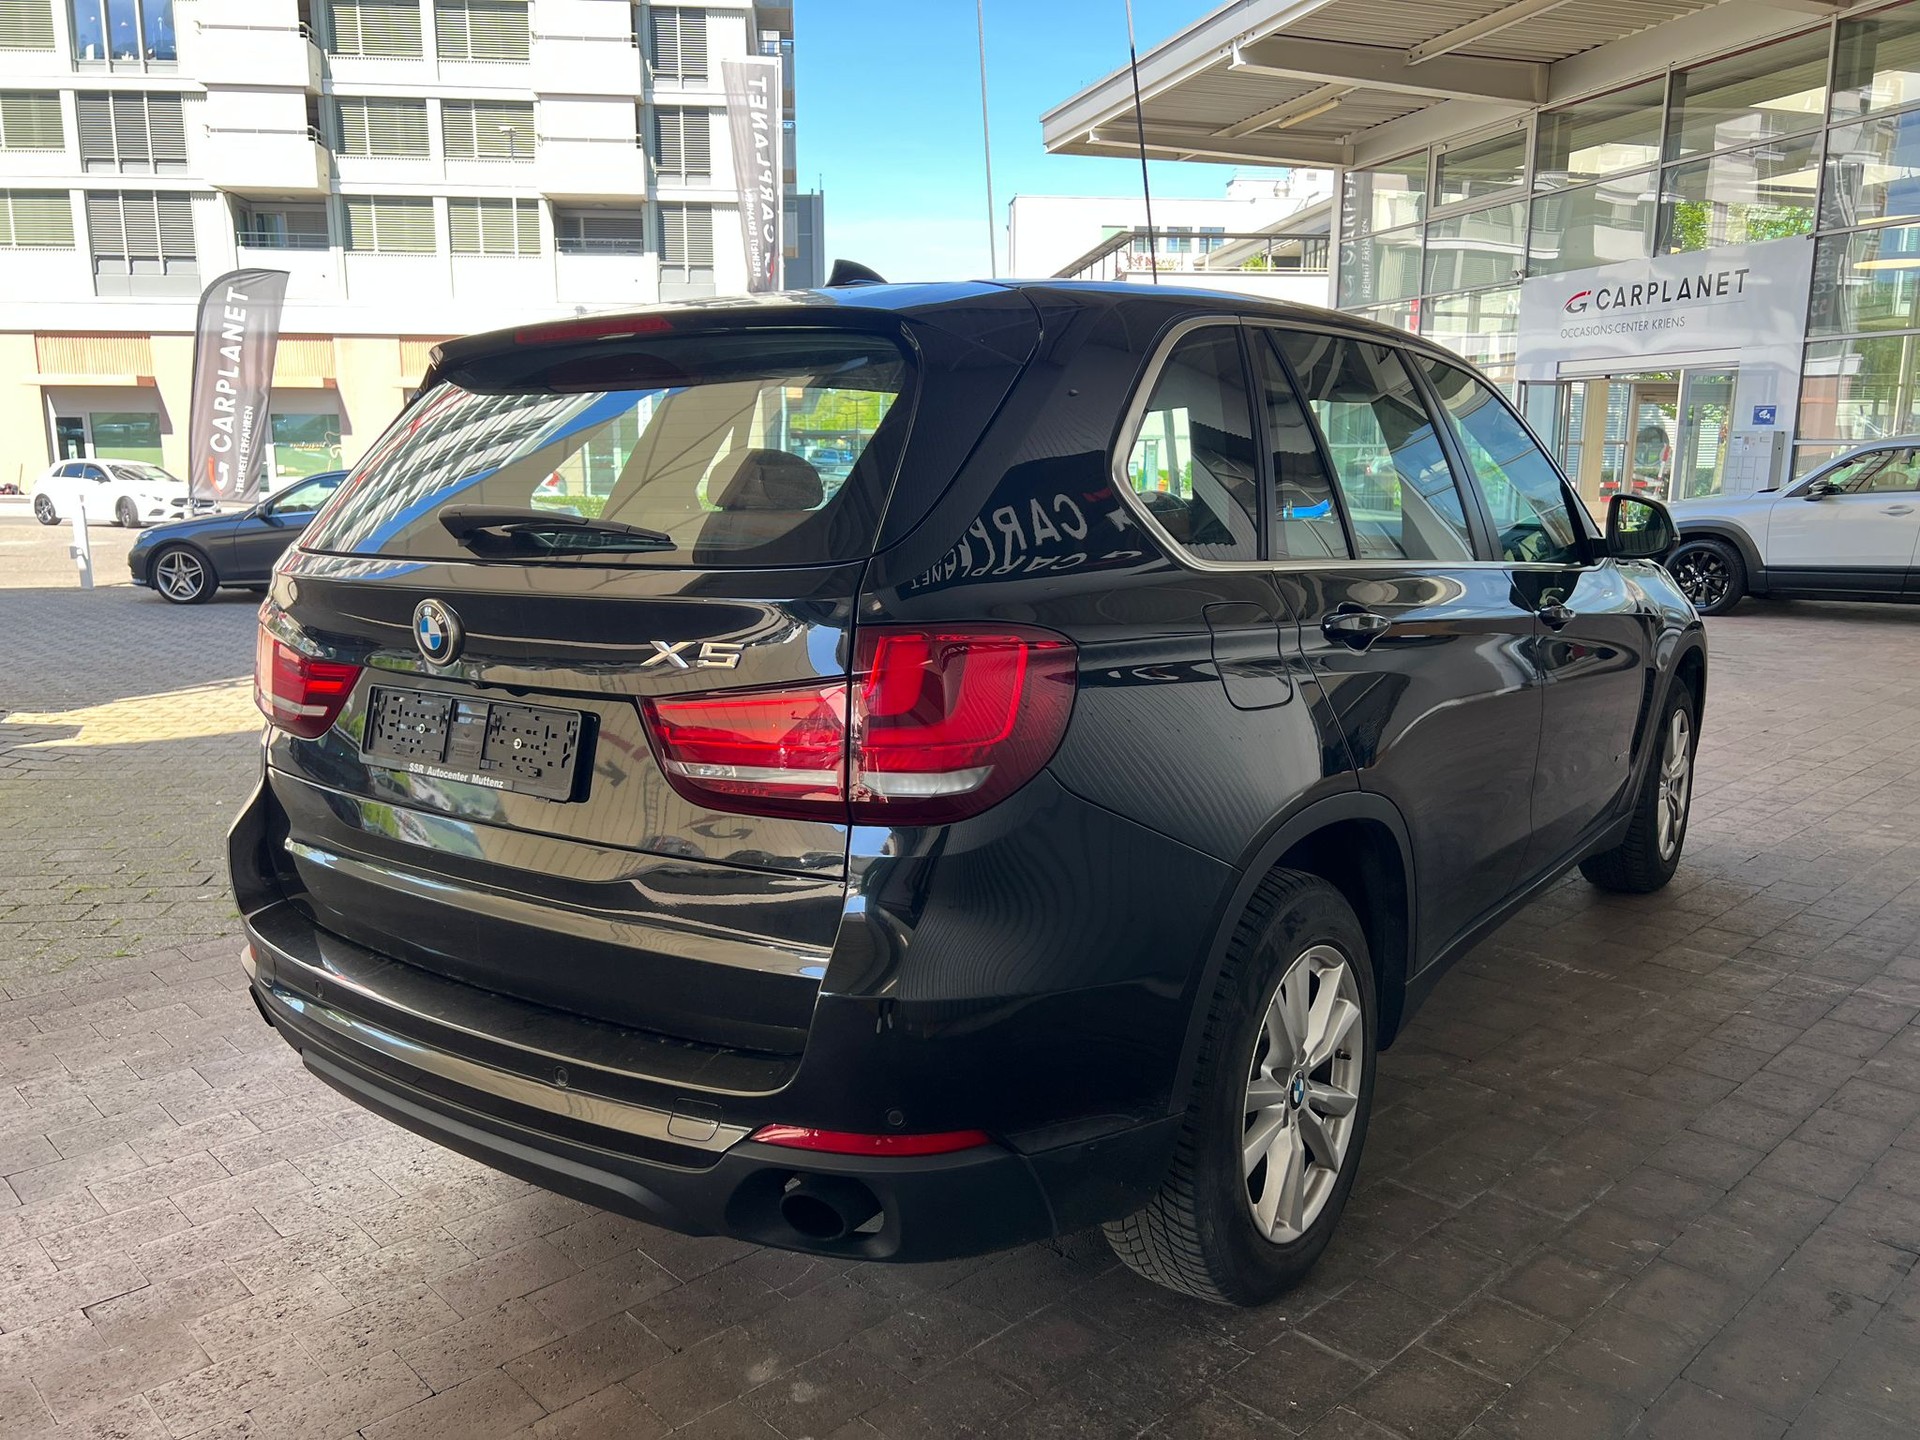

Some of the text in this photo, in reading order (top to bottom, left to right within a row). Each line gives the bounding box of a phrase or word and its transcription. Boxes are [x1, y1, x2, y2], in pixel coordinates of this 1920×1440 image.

[1596, 268, 1750, 311] CARPLANET
[1652, 316, 1686, 330] KRIENS
[209, 286, 249, 454] CARPLANET
[234, 405, 254, 494] FREIHEIT ERFAHREN
[640, 641, 745, 669] X5
[408, 762, 504, 789] SSR Autocenter Muttenz
